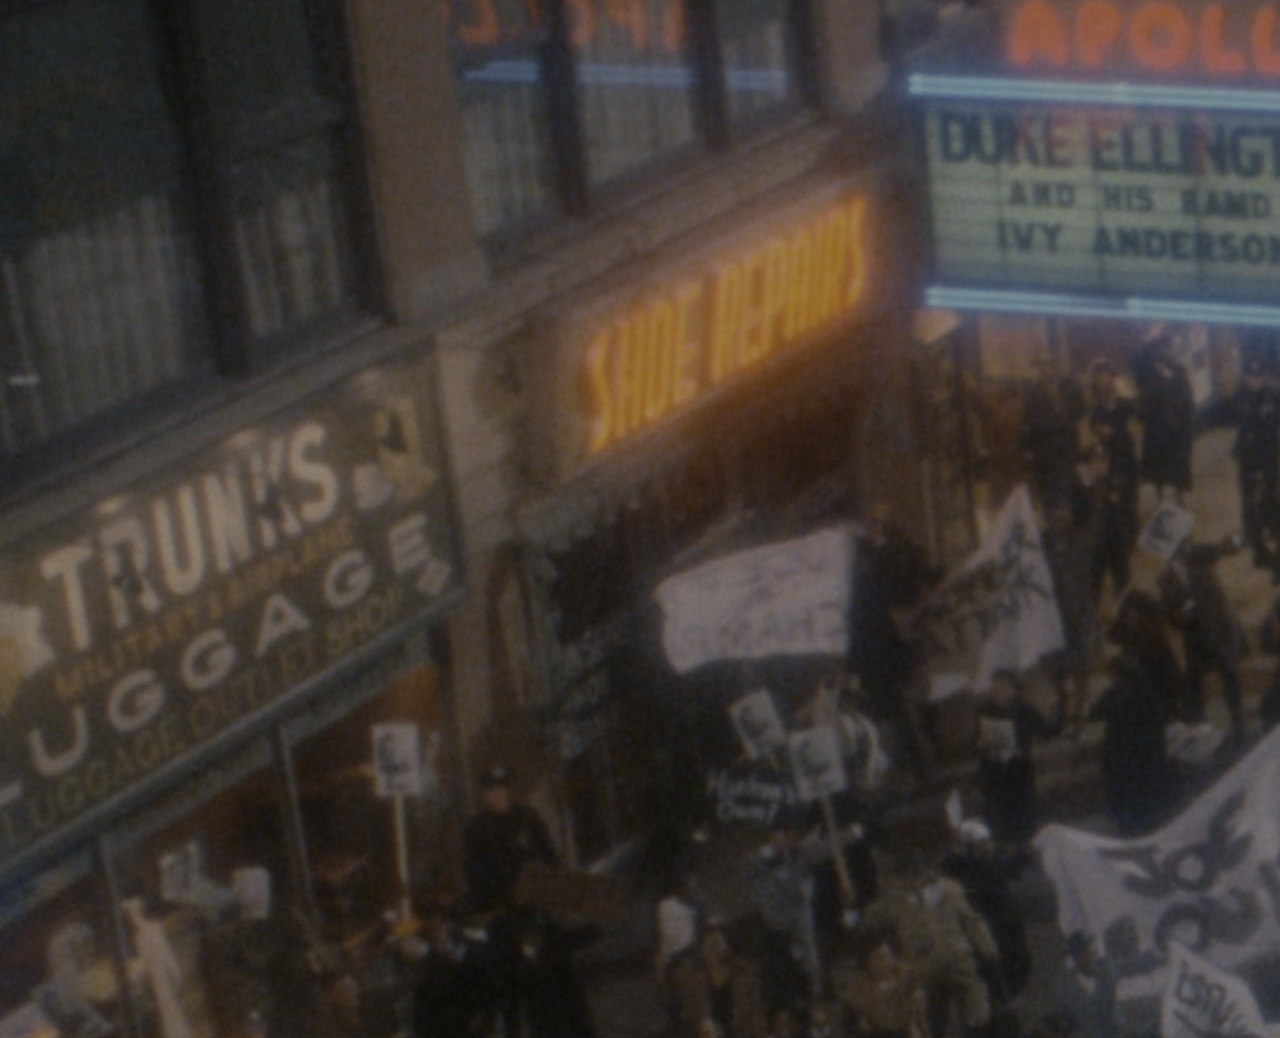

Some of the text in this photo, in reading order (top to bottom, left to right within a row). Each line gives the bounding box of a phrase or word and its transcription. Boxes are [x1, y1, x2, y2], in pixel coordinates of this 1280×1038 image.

[940, 110, 1073, 168] DUKE
[997, 222, 1063, 254] IVY
[1007, 181, 1076, 210] AND
[1103, 183, 1155, 214] HIS
[39, 421, 341, 653] TRUNKS
[0, 512, 430, 800] UGGAGE
[1096, 790, 1255, 900] JOE
